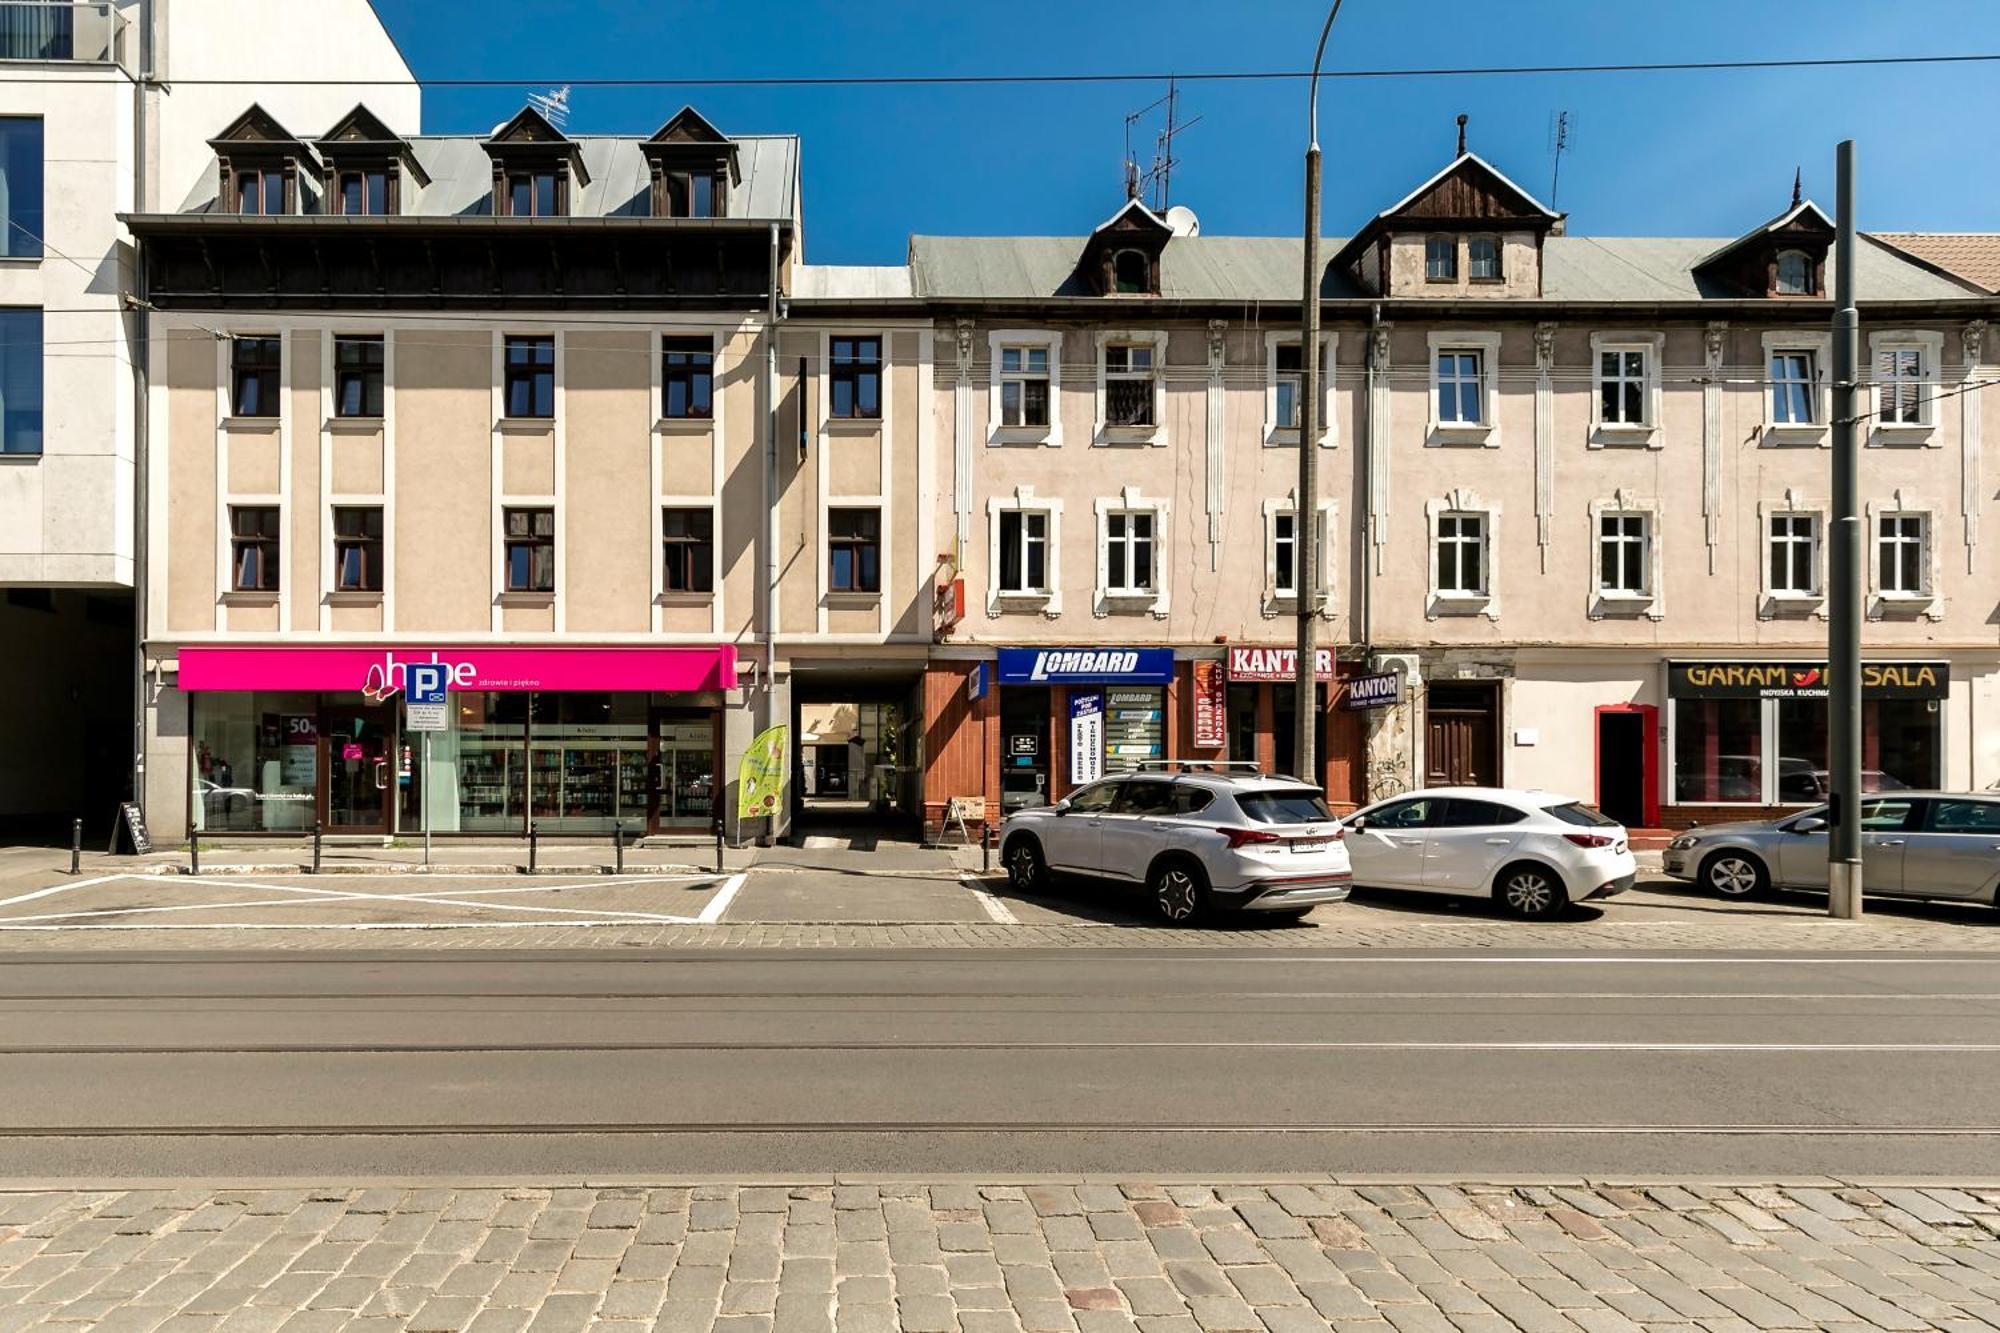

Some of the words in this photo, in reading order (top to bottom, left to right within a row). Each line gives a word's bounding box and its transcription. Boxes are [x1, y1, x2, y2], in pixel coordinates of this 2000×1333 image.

[386, 651, 476, 687] hbe
[1030, 651, 1138, 681] LOMBARD
[1234, 649, 1332, 673] KANTR
[415, 668, 439, 699] P
[478, 679, 508, 687] zdrowie
[513, 679, 540, 688] piękno
[1350, 675, 1397, 700] KANTOR
[1687, 667, 1787, 687] GARAM
[1823, 667, 1936, 687] SALA
[1110, 693, 1152, 705] LOMBARD
